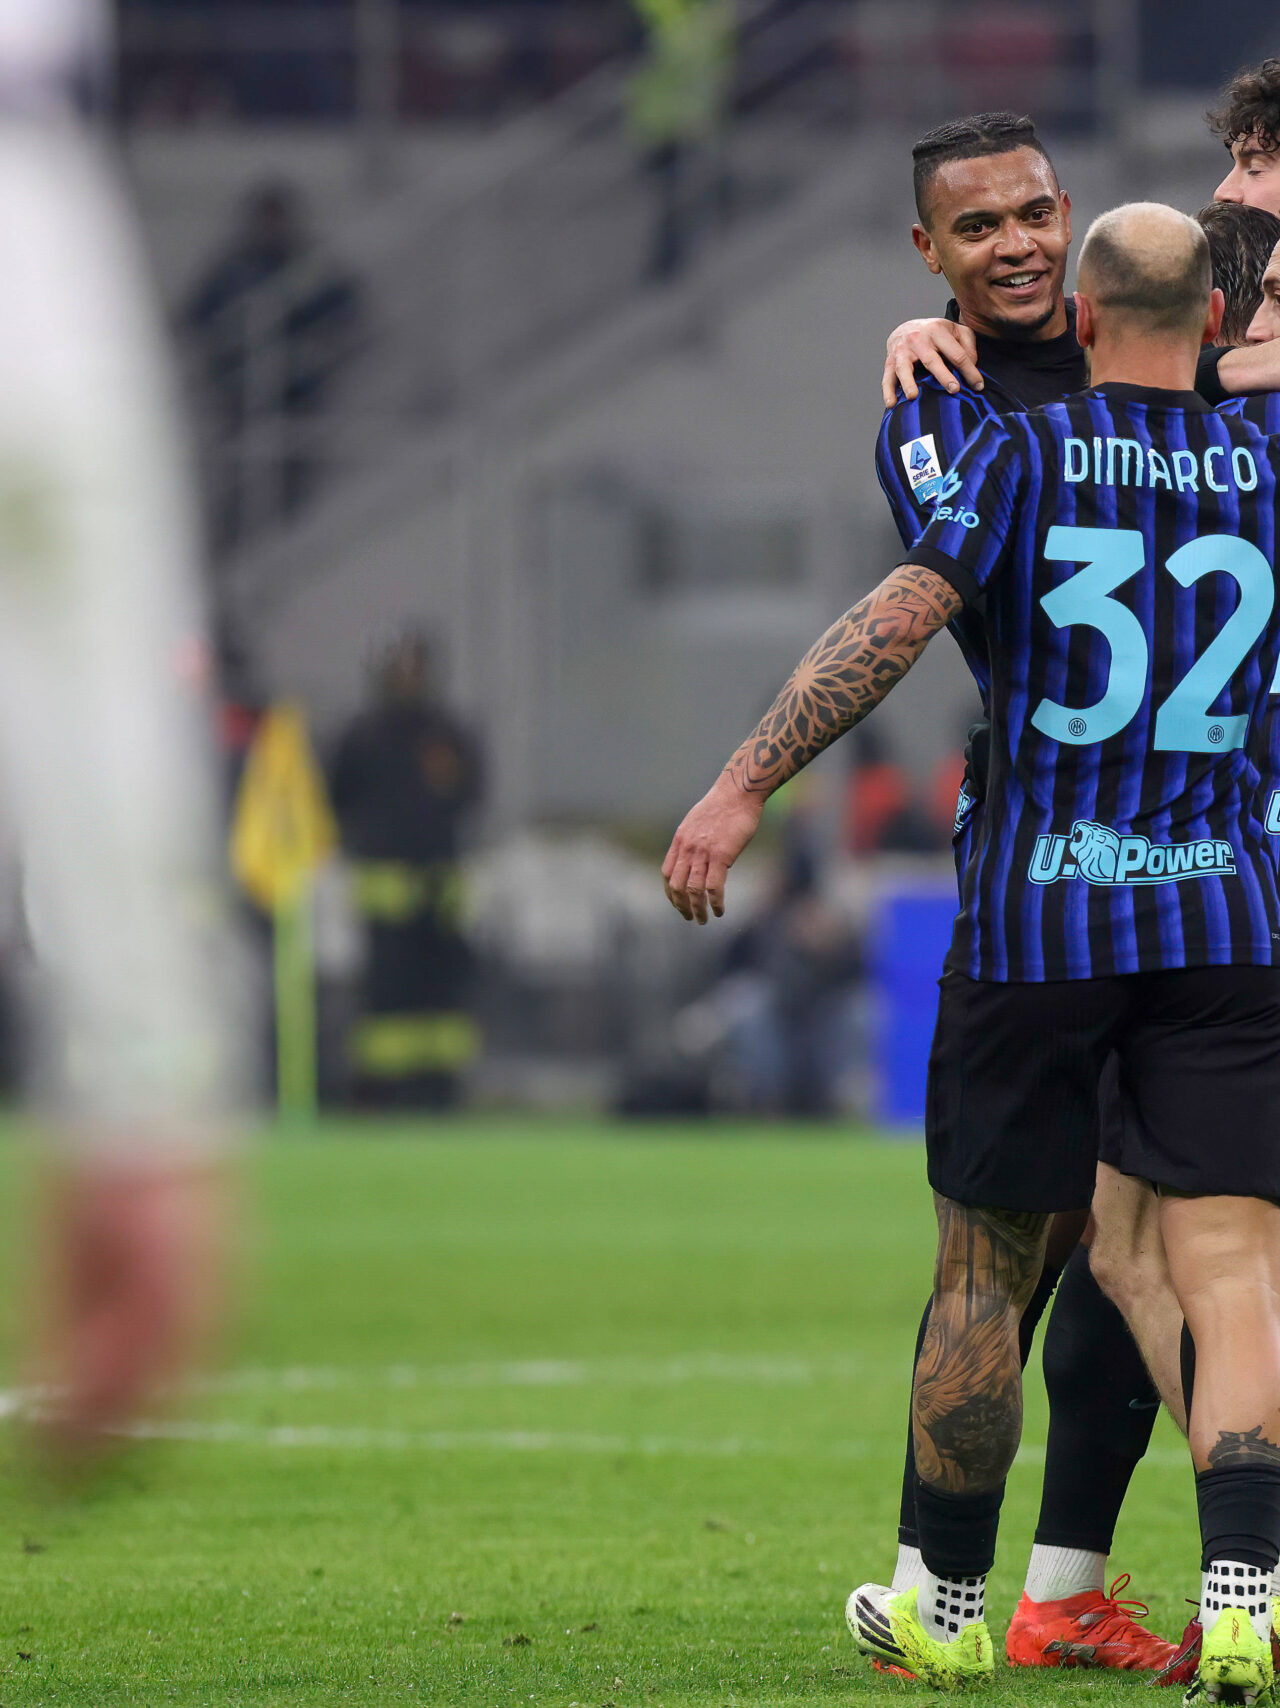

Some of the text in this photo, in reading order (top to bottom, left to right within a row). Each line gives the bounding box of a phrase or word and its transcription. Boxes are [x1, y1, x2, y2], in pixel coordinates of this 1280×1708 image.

[912, 469, 930, 483] SERIE
[1064, 437, 1258, 492] DIMARCO
[935, 506, 980, 529] e.io
[1030, 525, 1275, 753] 32
